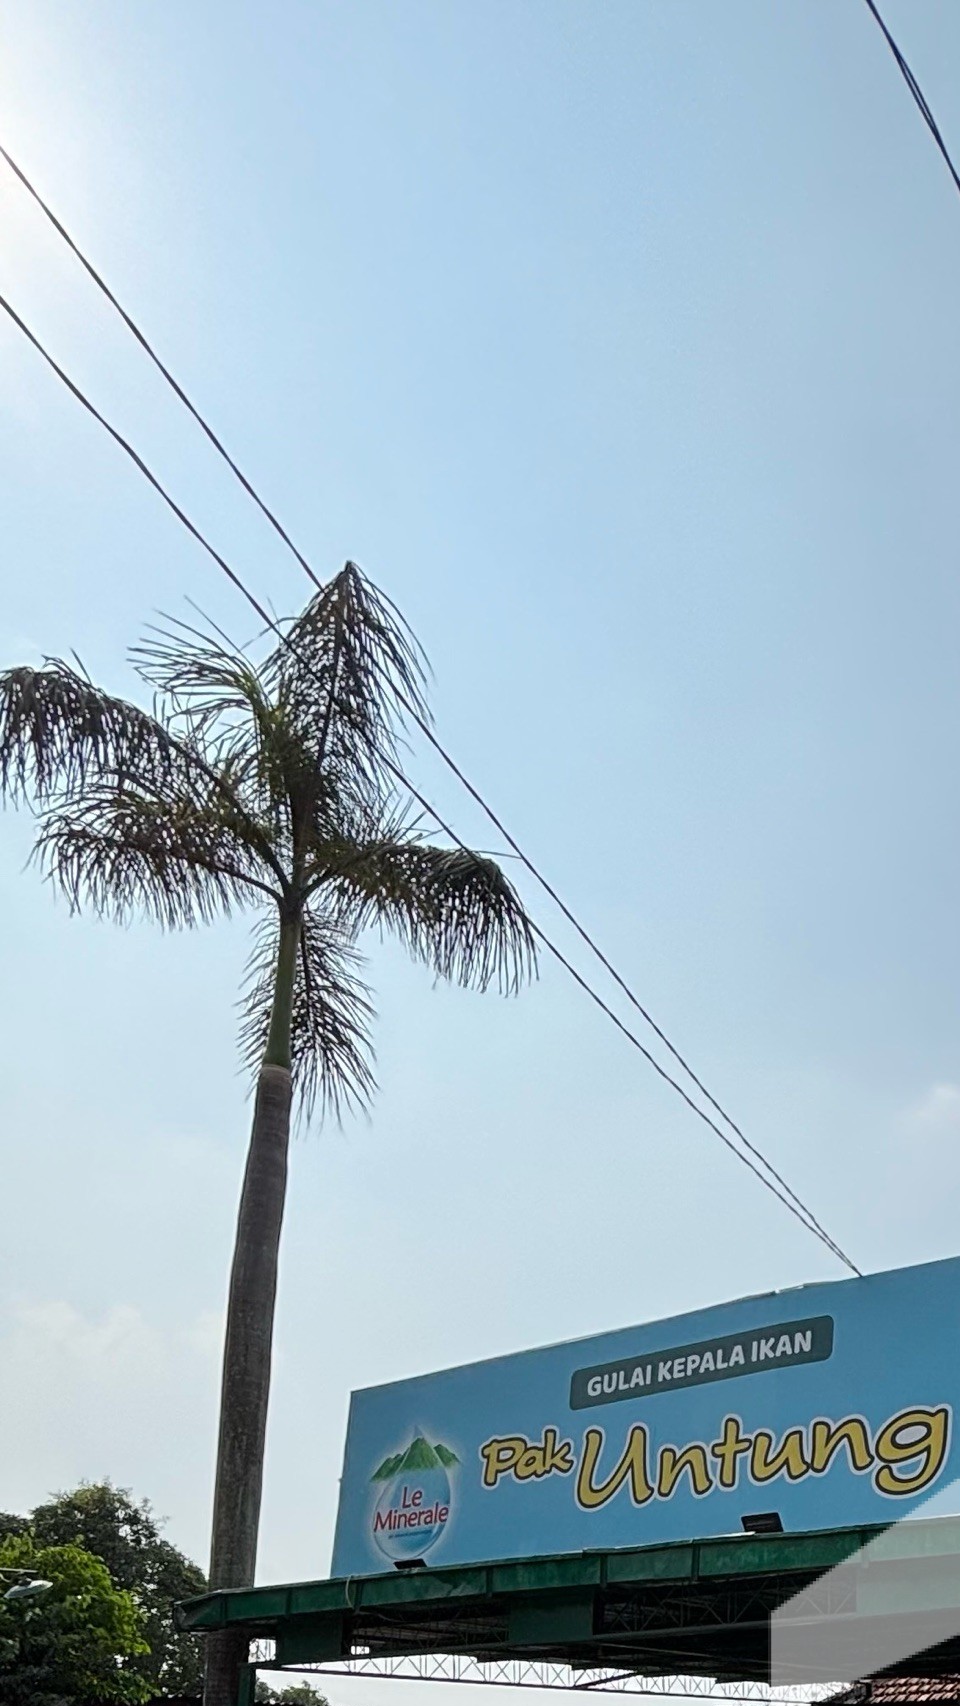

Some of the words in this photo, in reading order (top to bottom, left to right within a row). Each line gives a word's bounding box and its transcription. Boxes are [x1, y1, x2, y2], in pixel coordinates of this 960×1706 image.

[587, 1364, 652, 1397] GULAI
[657, 1345, 745, 1382] KEPALA
[751, 1331, 812, 1362] IKAN
[480, 1427, 574, 1487] Pak
[575, 1406, 950, 1509] Untung
[373, 1502, 449, 1532] Minerale
[402, 1486, 422, 1509] Le
